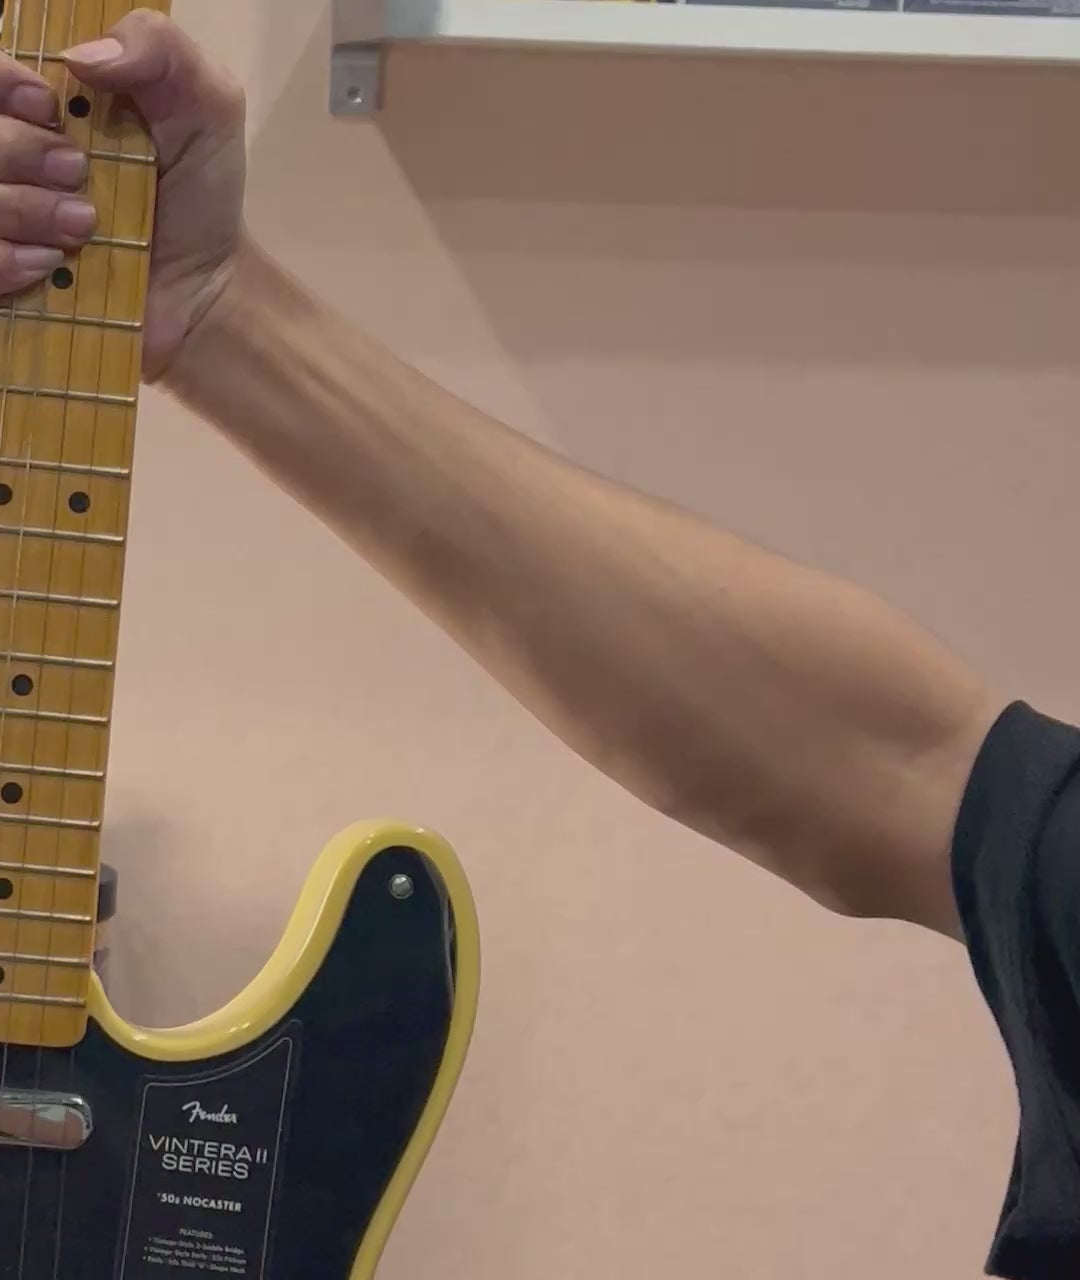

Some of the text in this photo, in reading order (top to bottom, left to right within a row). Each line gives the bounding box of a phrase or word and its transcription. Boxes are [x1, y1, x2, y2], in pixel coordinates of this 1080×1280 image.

[182, 1101, 238, 1124] Fender
[148, 1133, 268, 1164] VINTERA II
[161, 1153, 249, 1180] SERIES
[183, 1195, 242, 1212] NOCASTER
